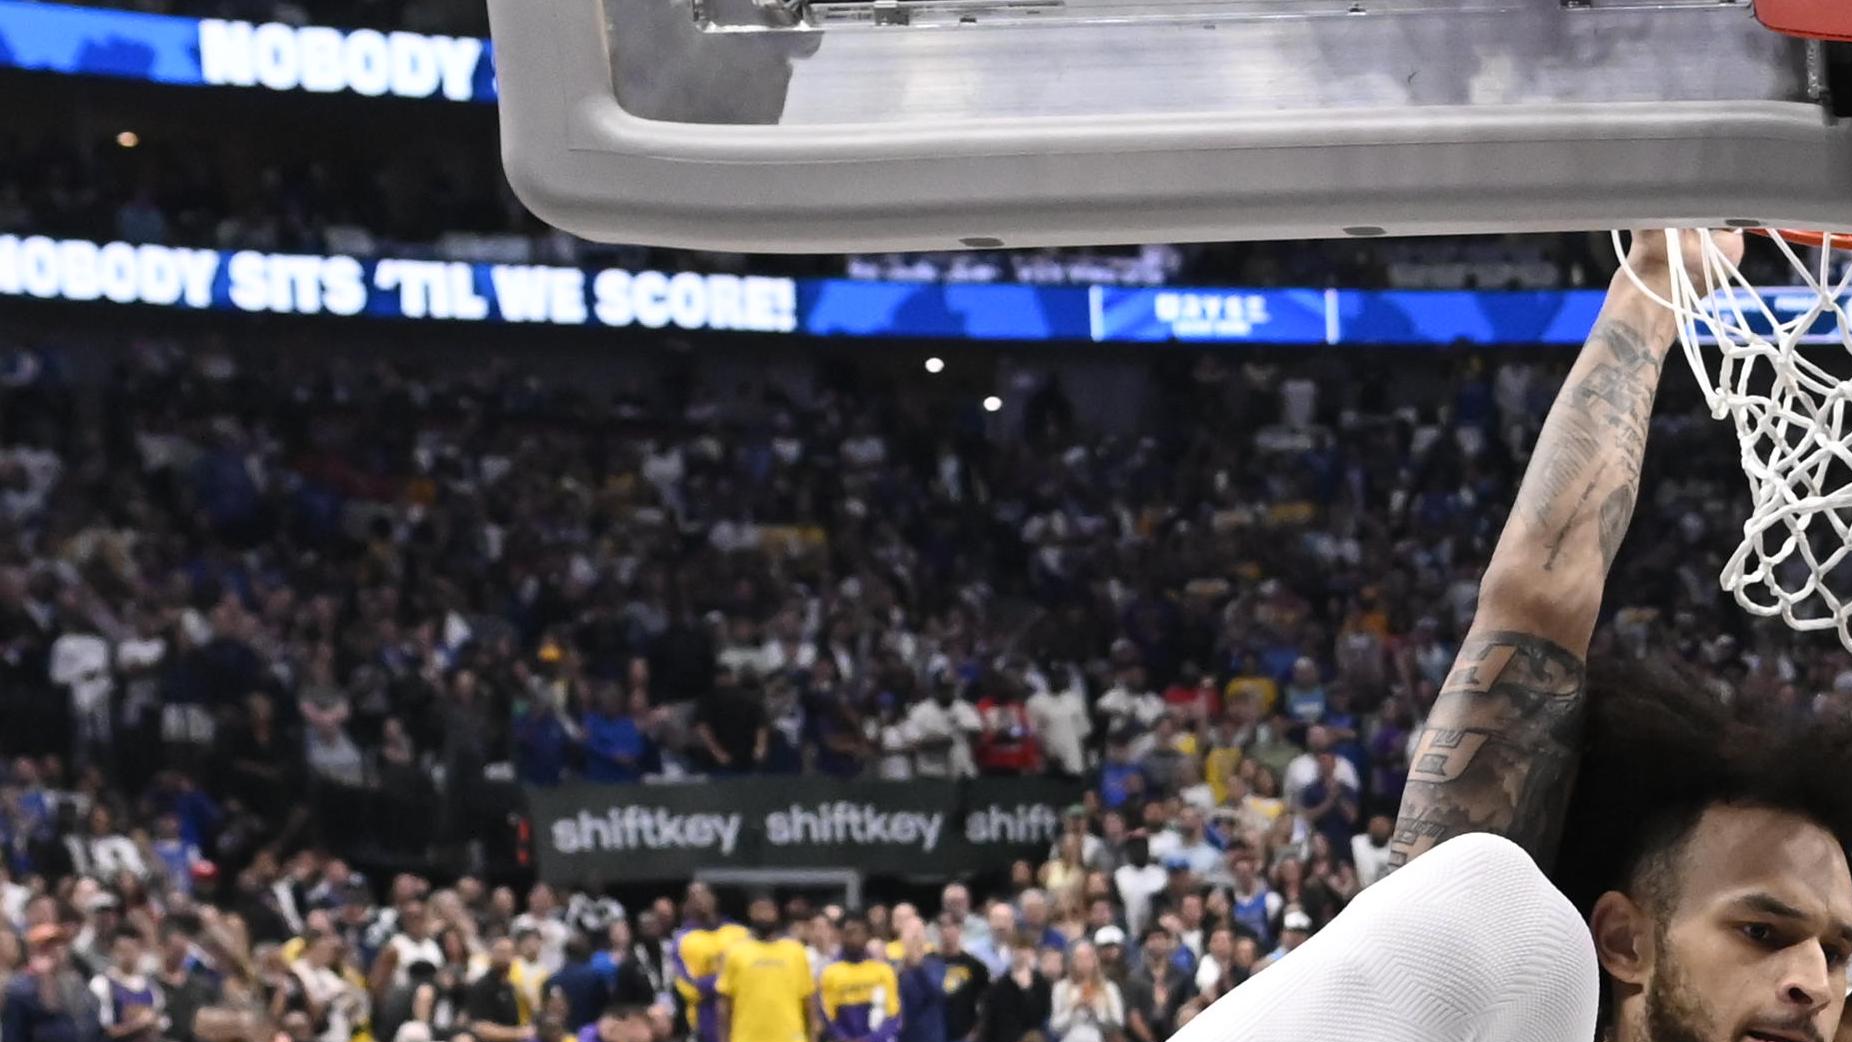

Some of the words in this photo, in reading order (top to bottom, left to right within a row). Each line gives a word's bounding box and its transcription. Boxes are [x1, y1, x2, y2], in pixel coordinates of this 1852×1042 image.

[199, 19, 483, 101] NOBODY
[228, 249, 368, 316] SITS
[490, 263, 588, 326] WE
[593, 267, 799, 334] SCORE!
[551, 804, 741, 856] shiftkey
[765, 801, 944, 852] shiftkey
